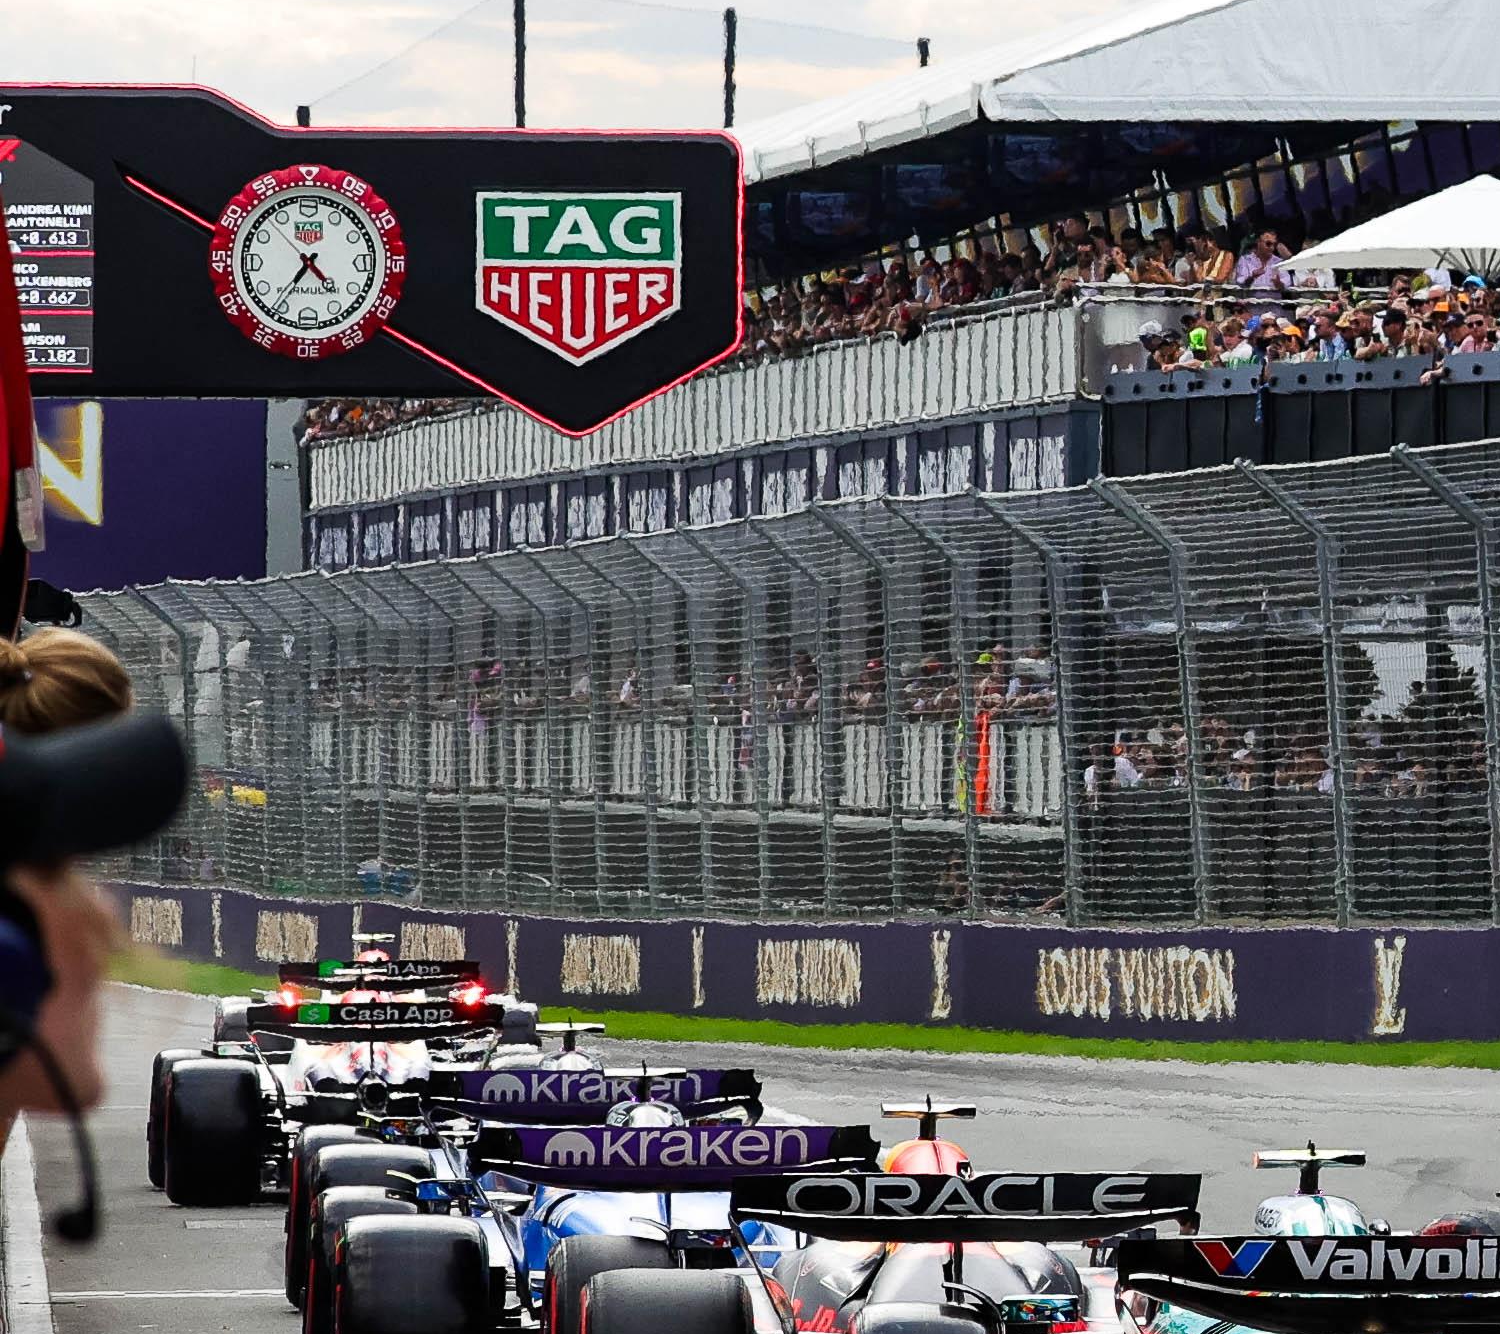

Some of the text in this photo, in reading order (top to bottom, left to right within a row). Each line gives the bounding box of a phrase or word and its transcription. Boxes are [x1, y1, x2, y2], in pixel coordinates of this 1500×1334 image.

[252, 175, 276, 195] 55
[343, 177, 367, 196] 05
[7, 205, 92, 216] ANDREA KIMI
[221, 205, 241, 229] 50
[379, 209, 396, 229] 10
[8, 217, 81, 228] ANTONELLI
[494, 206, 661, 255] TAG
[20, 232, 77, 245] +0.613
[212, 251, 226, 273] 45
[392, 255, 405, 273] 15
[17, 291, 76, 304] +0.667
[489, 274, 668, 347] HEUER
[1037, 945, 1238, 1022] LOUIS VUITTON
[341, 1005, 398, 1022] Cash
[405, 1005, 455, 1024] App
[603, 1126, 809, 1166] kraken
[787, 1176, 1149, 1217] ORACLE
